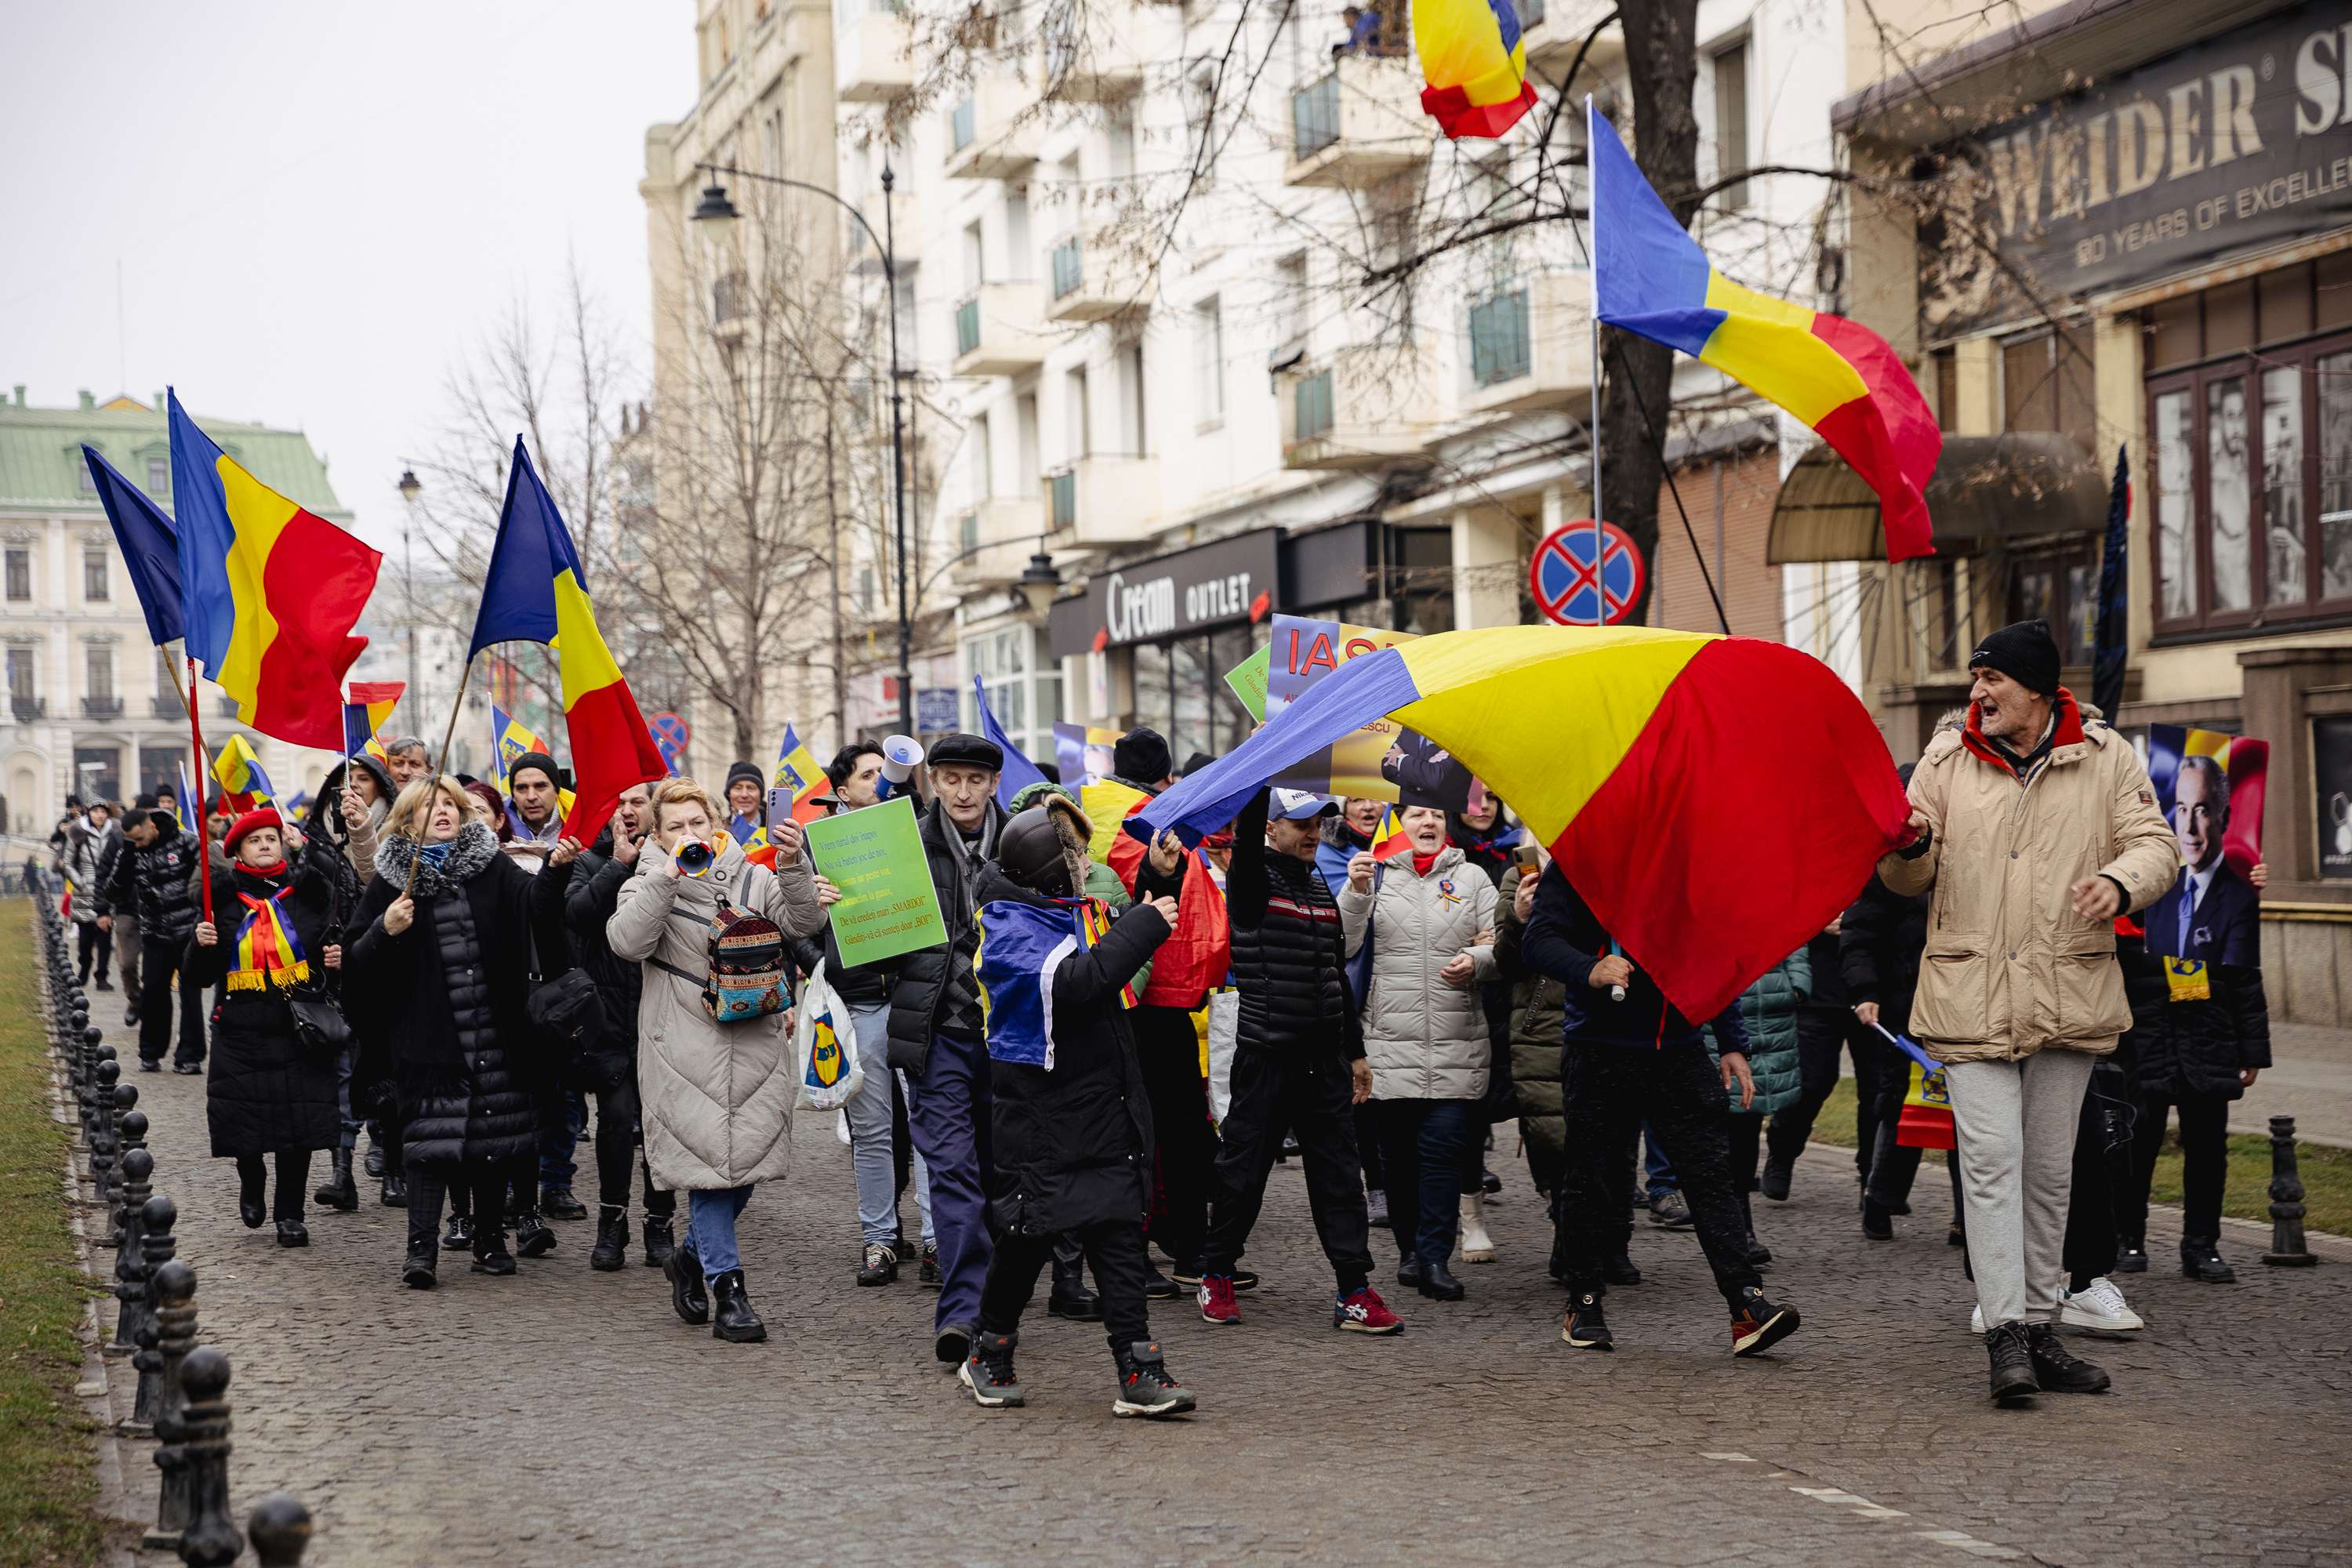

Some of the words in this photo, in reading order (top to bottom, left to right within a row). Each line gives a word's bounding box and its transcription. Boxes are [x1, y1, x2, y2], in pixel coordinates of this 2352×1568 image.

[2114, 208, 2188, 254] YEARS
[2197, 194, 2229, 231] OF
[2235, 155, 2352, 220] EXCELLE
[1106, 572, 1176, 642] Cream
[1185, 572, 1250, 622] OUTLET
[1255, 666, 1264, 677] De
[1360, 721, 1390, 733] SCU
[818, 842, 836, 851] Vrem
[836, 836, 850, 848] turul
[851, 832, 859, 844] doi
[824, 861, 834, 871] Nu
[834, 858, 841, 868] vă
[857, 852, 867, 866] joc
[869, 849, 875, 859] de
[839, 875, 857, 887] venim
[856, 873, 865, 883] iar
[865, 870, 880, 884] peste
[845, 894, 869, 906] aruncăm
[867, 891, 875, 900] la
[839, 917, 849, 927] De
[849, 915, 856, 924] vă
[877, 906, 889, 917] mari
[874, 928, 881, 938] că
[900, 921, 913, 931] doar
